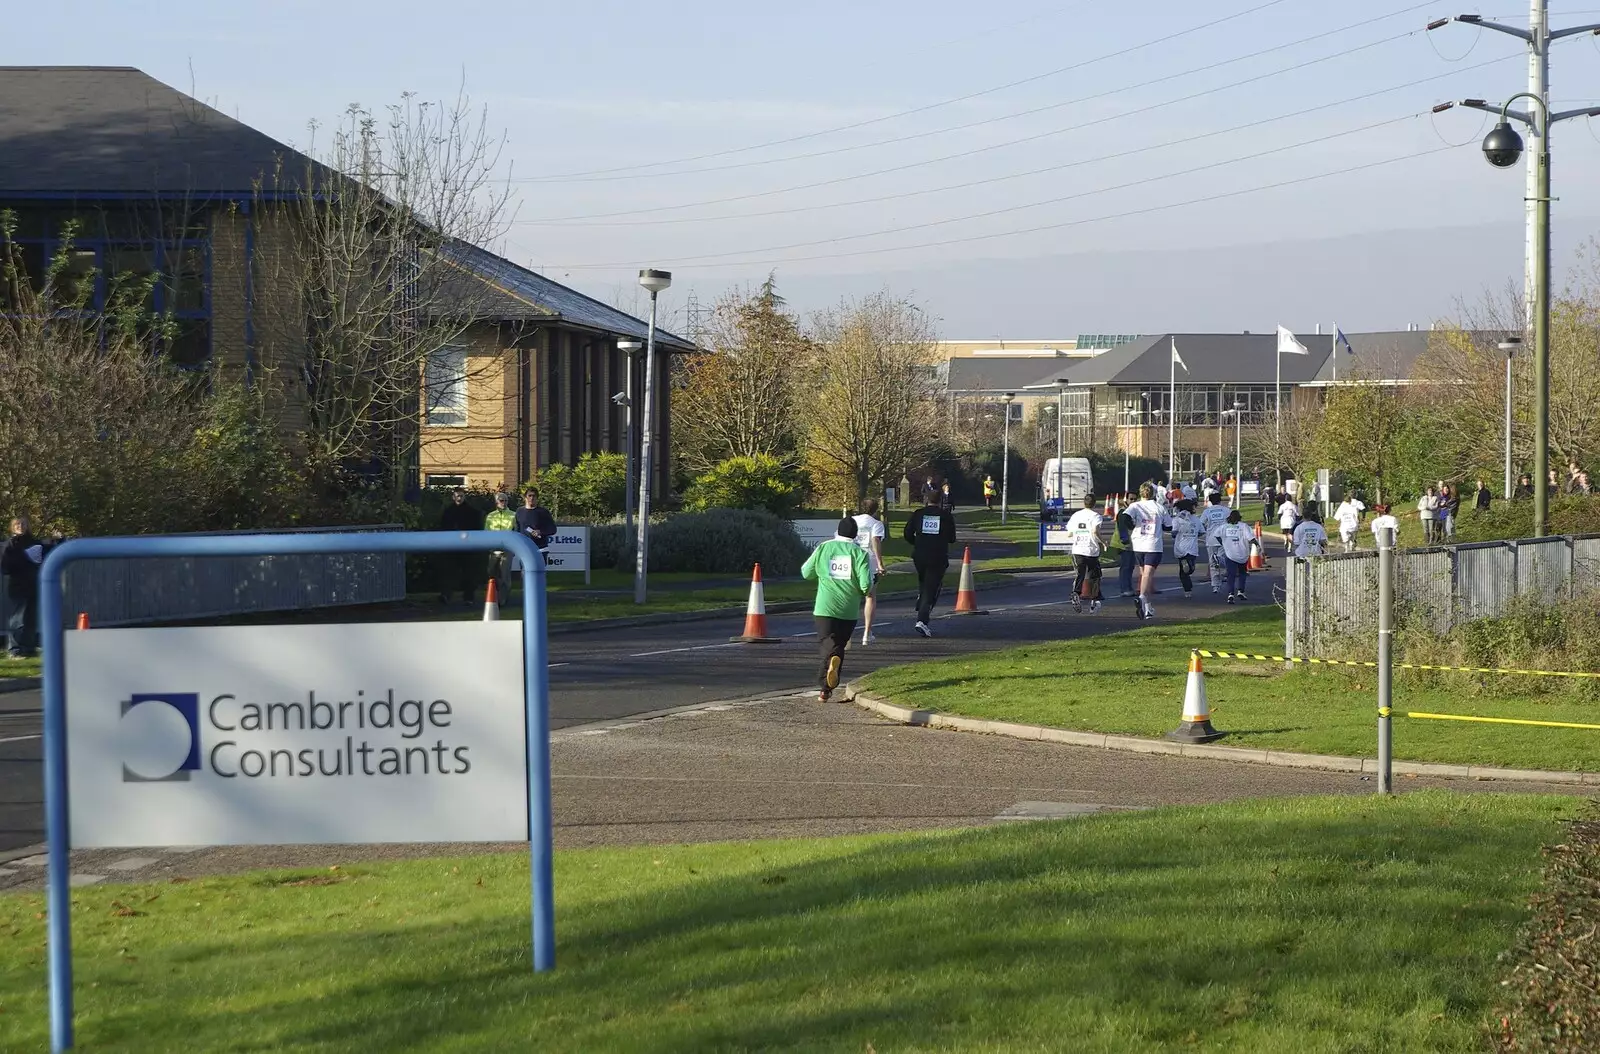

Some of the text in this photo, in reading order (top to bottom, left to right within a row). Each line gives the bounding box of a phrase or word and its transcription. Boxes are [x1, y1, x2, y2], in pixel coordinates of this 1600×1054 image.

[925, 521, 938, 529] 028
[555, 535, 583, 544] Little
[831, 562, 849, 572] 049
[208, 689, 453, 739] Cambridge
[209, 736, 472, 778] Consultants
